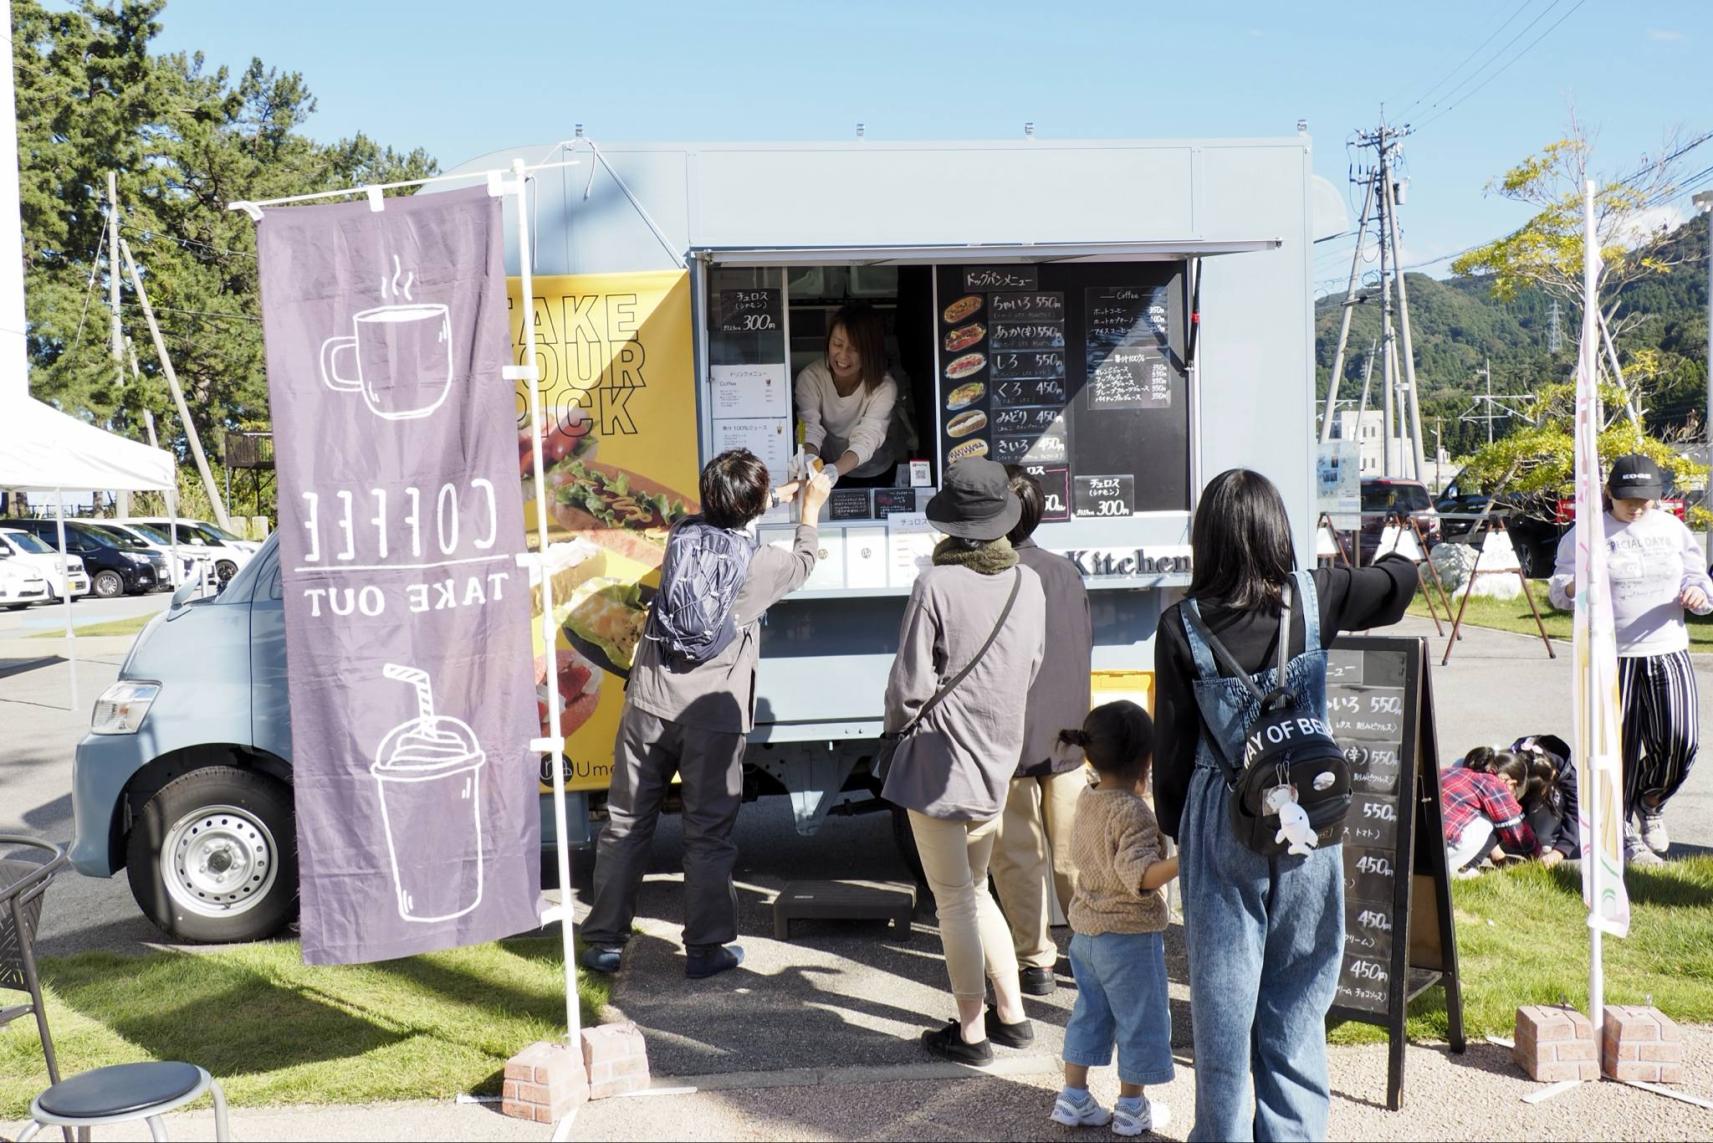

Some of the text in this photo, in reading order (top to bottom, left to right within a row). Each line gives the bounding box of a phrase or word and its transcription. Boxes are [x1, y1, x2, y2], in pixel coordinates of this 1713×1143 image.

[736, 291, 769, 302] チュロス
[992, 295, 1061, 311] ちゃいろ 550円
[1116, 290, 1139, 299] Coffee
[508, 294, 639, 344] AKE
[742, 314, 776, 331] 300円
[512, 340, 647, 391] OUR
[997, 354, 1063, 370] しろ 550円
[998, 381, 1063, 398] くろ 450円
[996, 409, 1028, 425] みどり
[1026, 466, 1046, 476] ロス
[1089, 479, 1120, 489] チュロス
[1096, 500, 1129, 516] 300円
[1066, 549, 1192, 576] Kitchen
[1326, 696, 1402, 715] いろ 550円
[1266, 720, 1294, 743] OF
[1363, 802, 1397, 822] 550円
[1355, 855, 1394, 877] 450円
[1357, 910, 1392, 930] 450円
[1350, 959, 1389, 982] 450円
